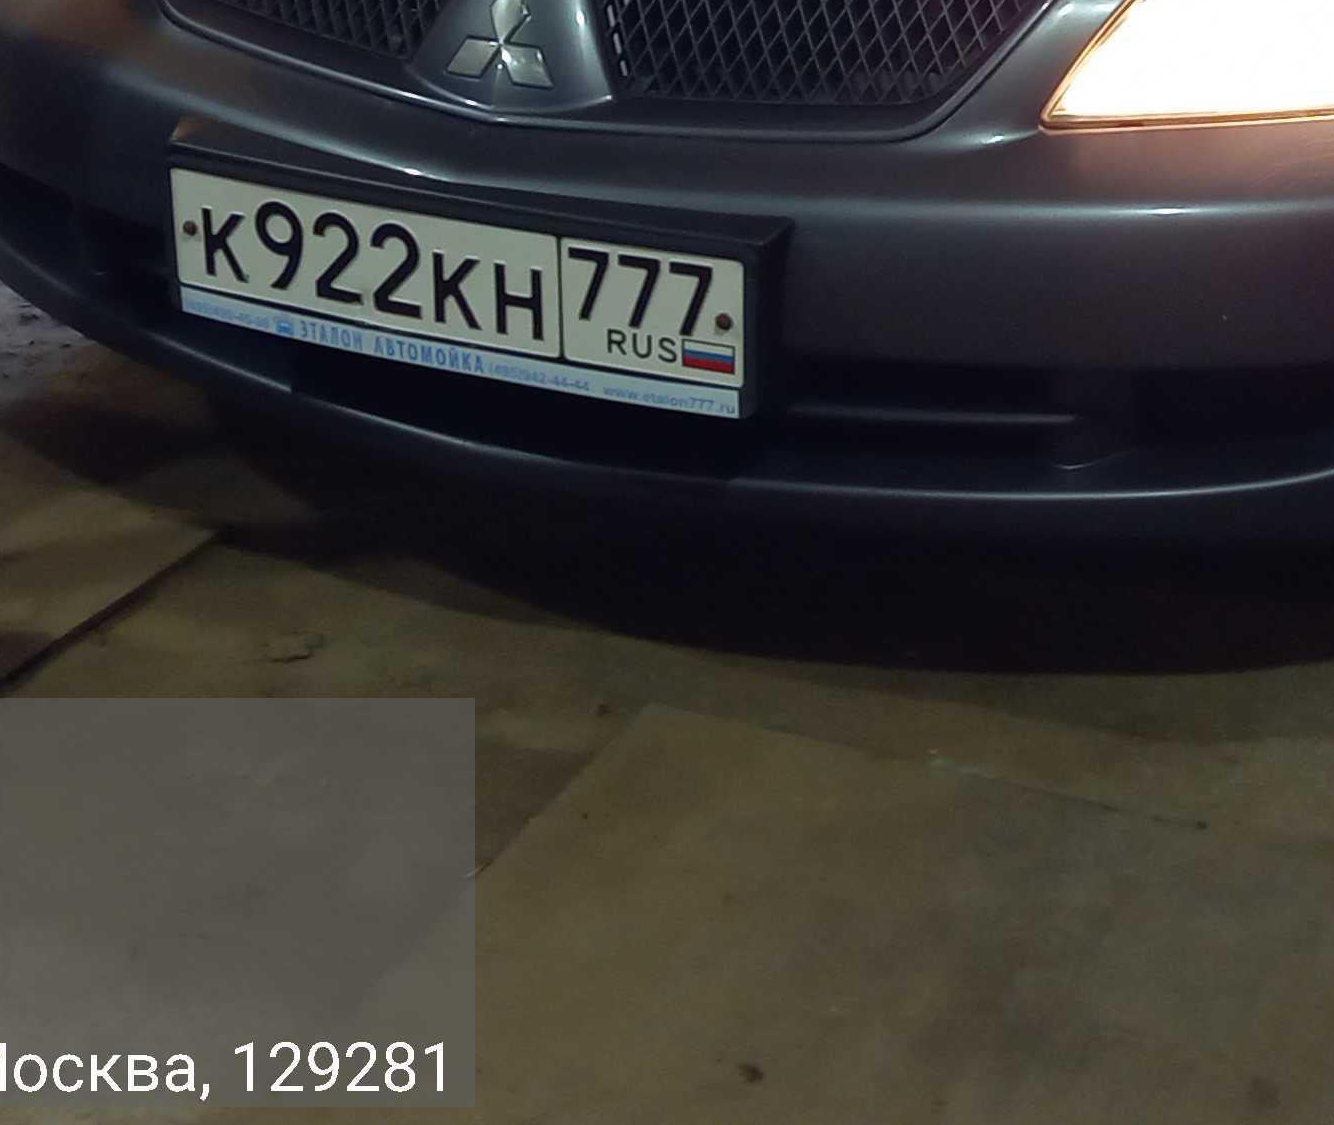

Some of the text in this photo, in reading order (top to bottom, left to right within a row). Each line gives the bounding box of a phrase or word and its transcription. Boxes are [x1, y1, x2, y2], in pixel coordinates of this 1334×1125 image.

[200, 200, 714, 341] К922КН 777
[300, 320, 364, 351] ЭТАЛОН
[373, 335, 484, 373] АВТОМОЙКА
[607, 328, 678, 363] RUS
